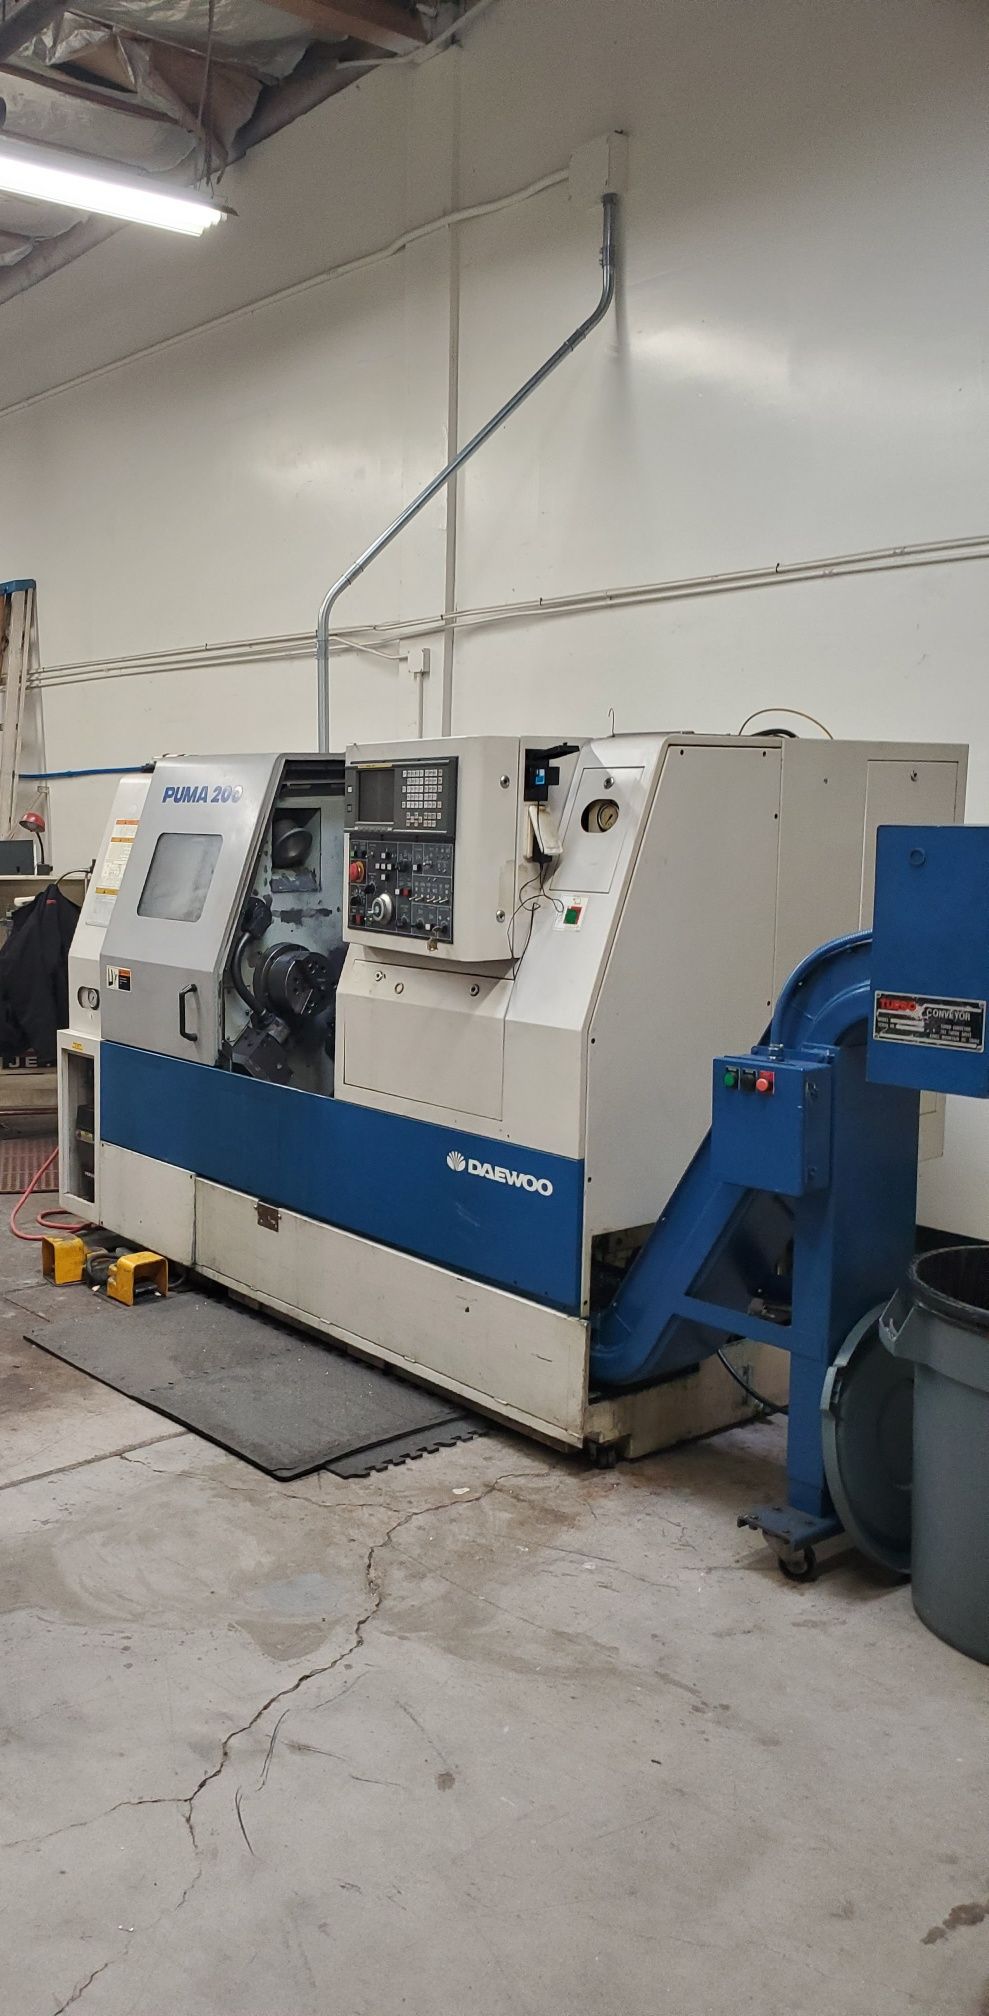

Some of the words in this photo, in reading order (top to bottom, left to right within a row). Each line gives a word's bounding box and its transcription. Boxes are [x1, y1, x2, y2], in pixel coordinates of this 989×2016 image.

[162, 786, 208, 803] PUMA
[211, 785, 243, 803] 200
[926, 1009, 971, 1021] CONVEYOR
[467, 1158, 553, 1197] DAEWOO
